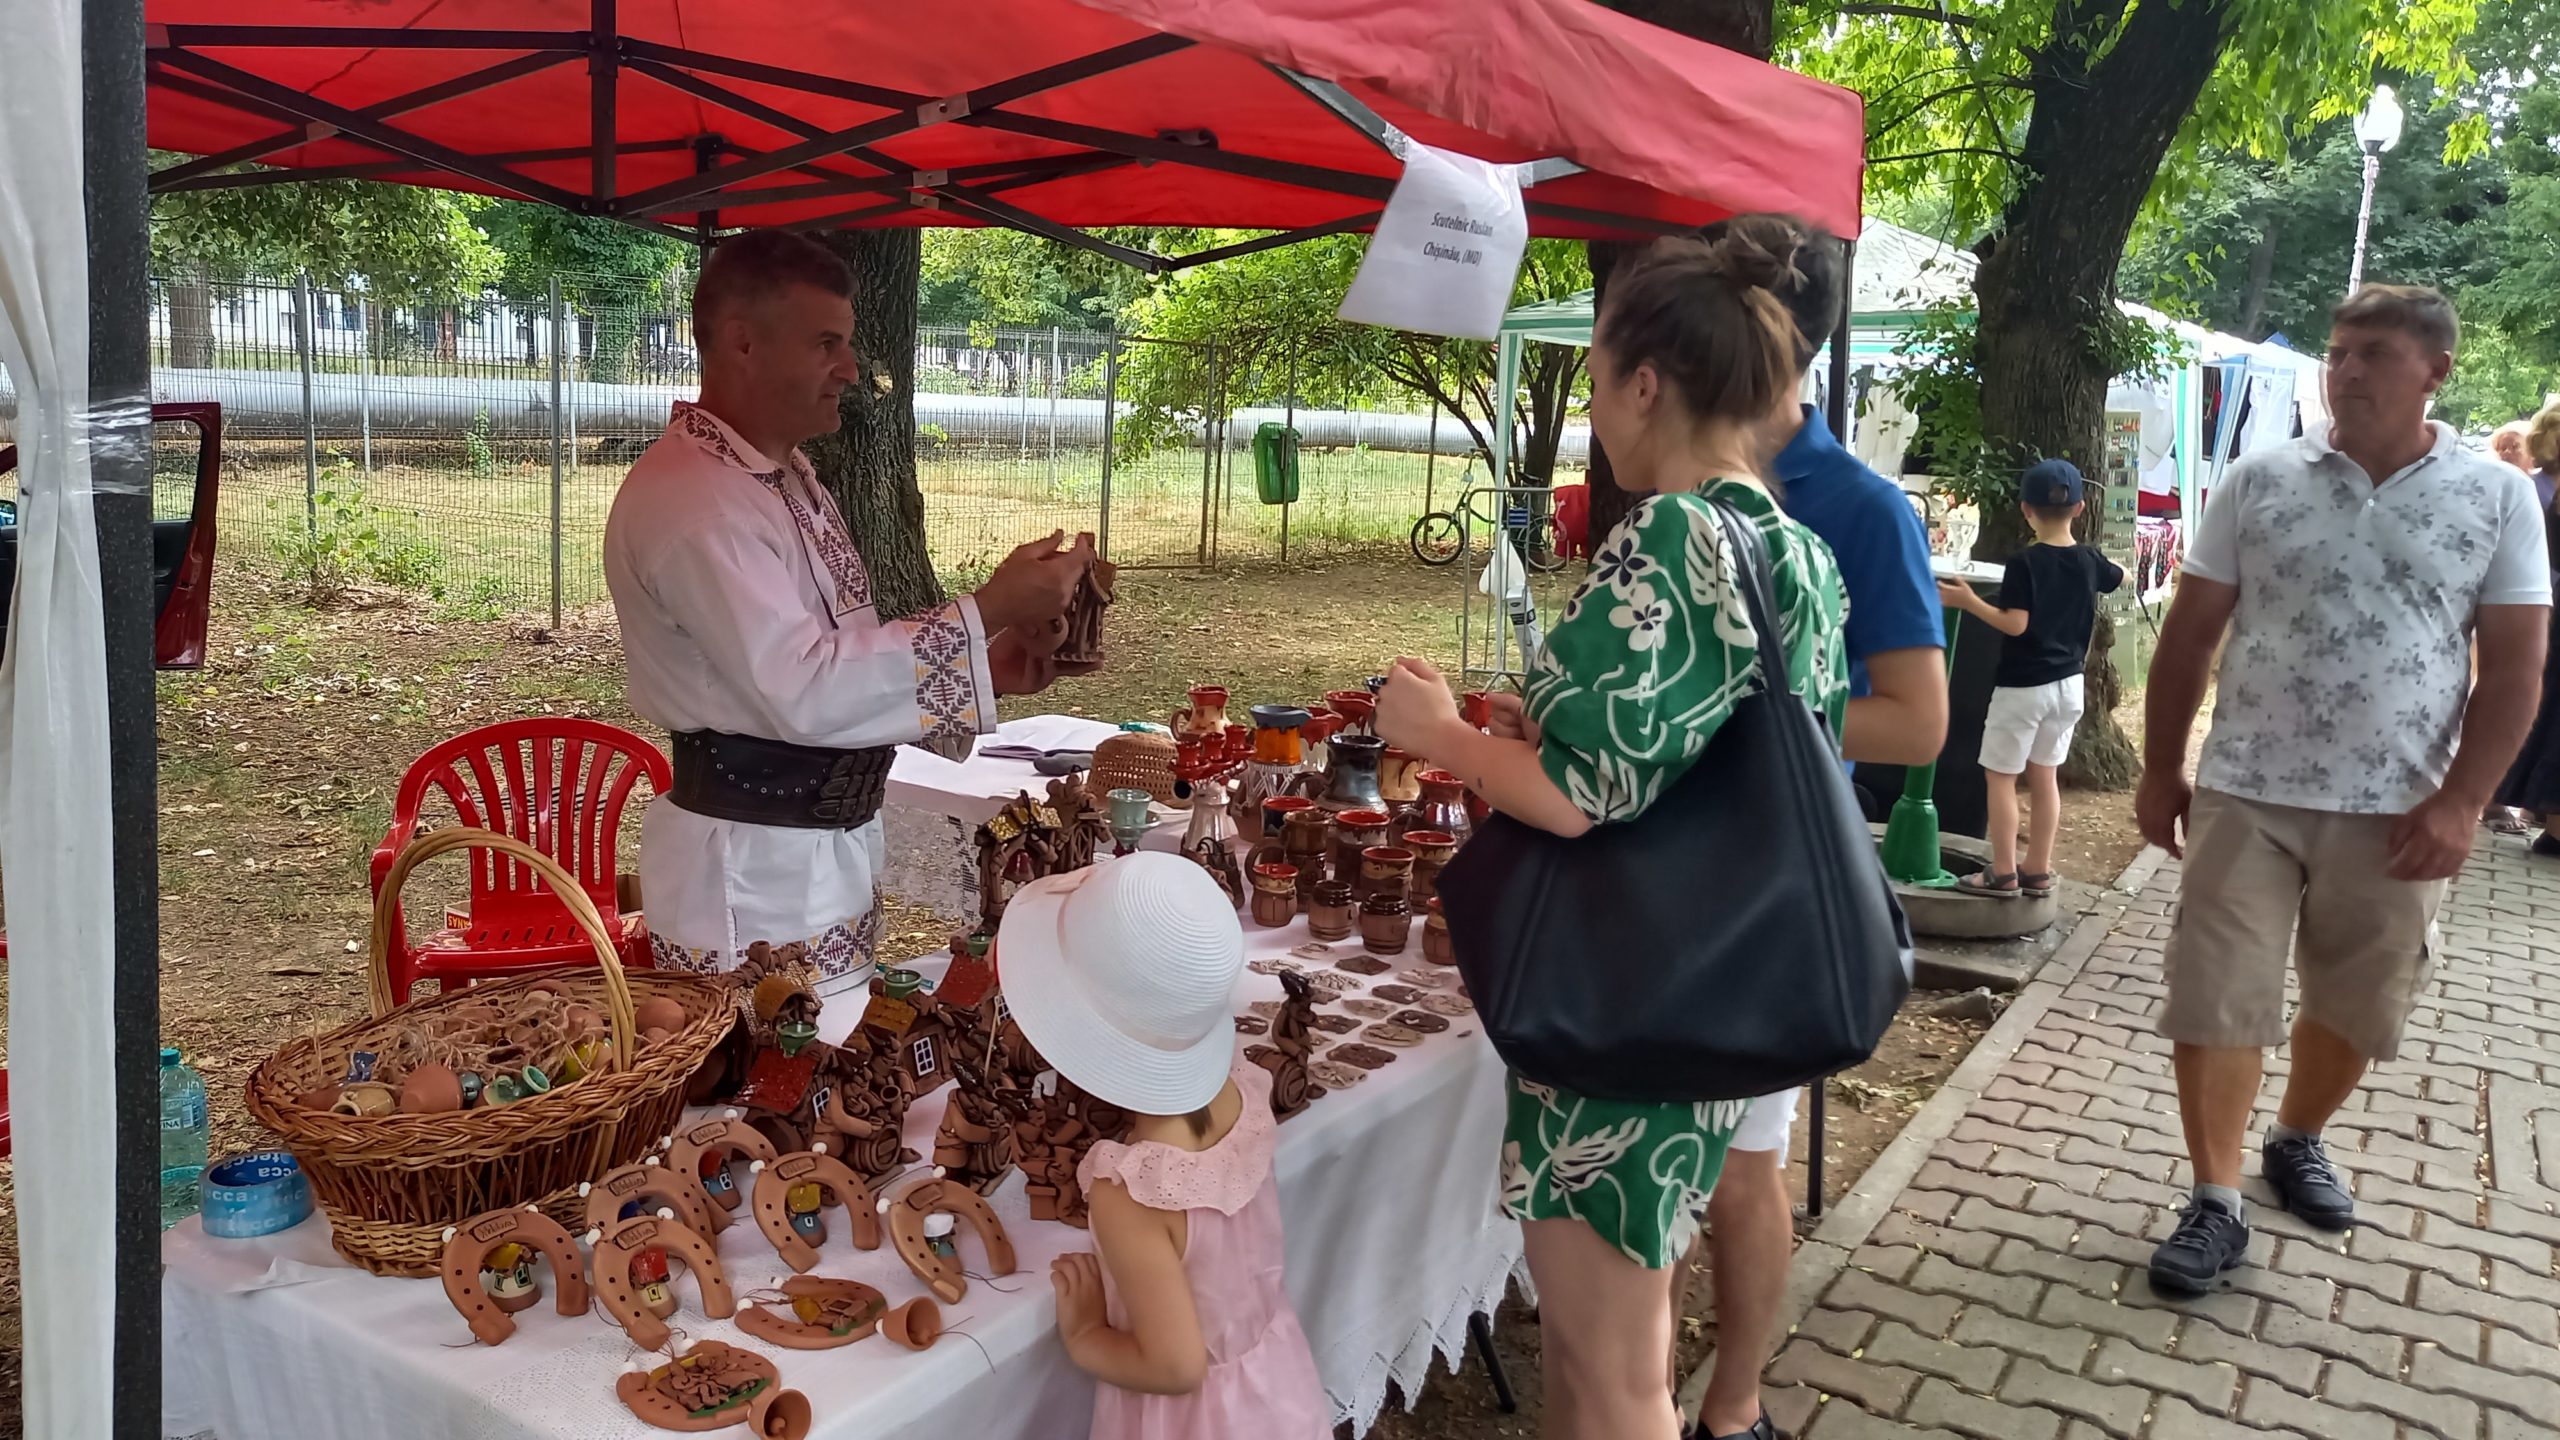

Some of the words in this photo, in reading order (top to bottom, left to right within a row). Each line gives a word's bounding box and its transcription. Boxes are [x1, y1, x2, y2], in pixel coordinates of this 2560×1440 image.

[1431, 212, 1469, 232] Scutelnic
[1468, 219, 1493, 237] Ruslan
[1461, 249, 1482, 267] (MD)
[257, 1166, 297, 1177] cca
